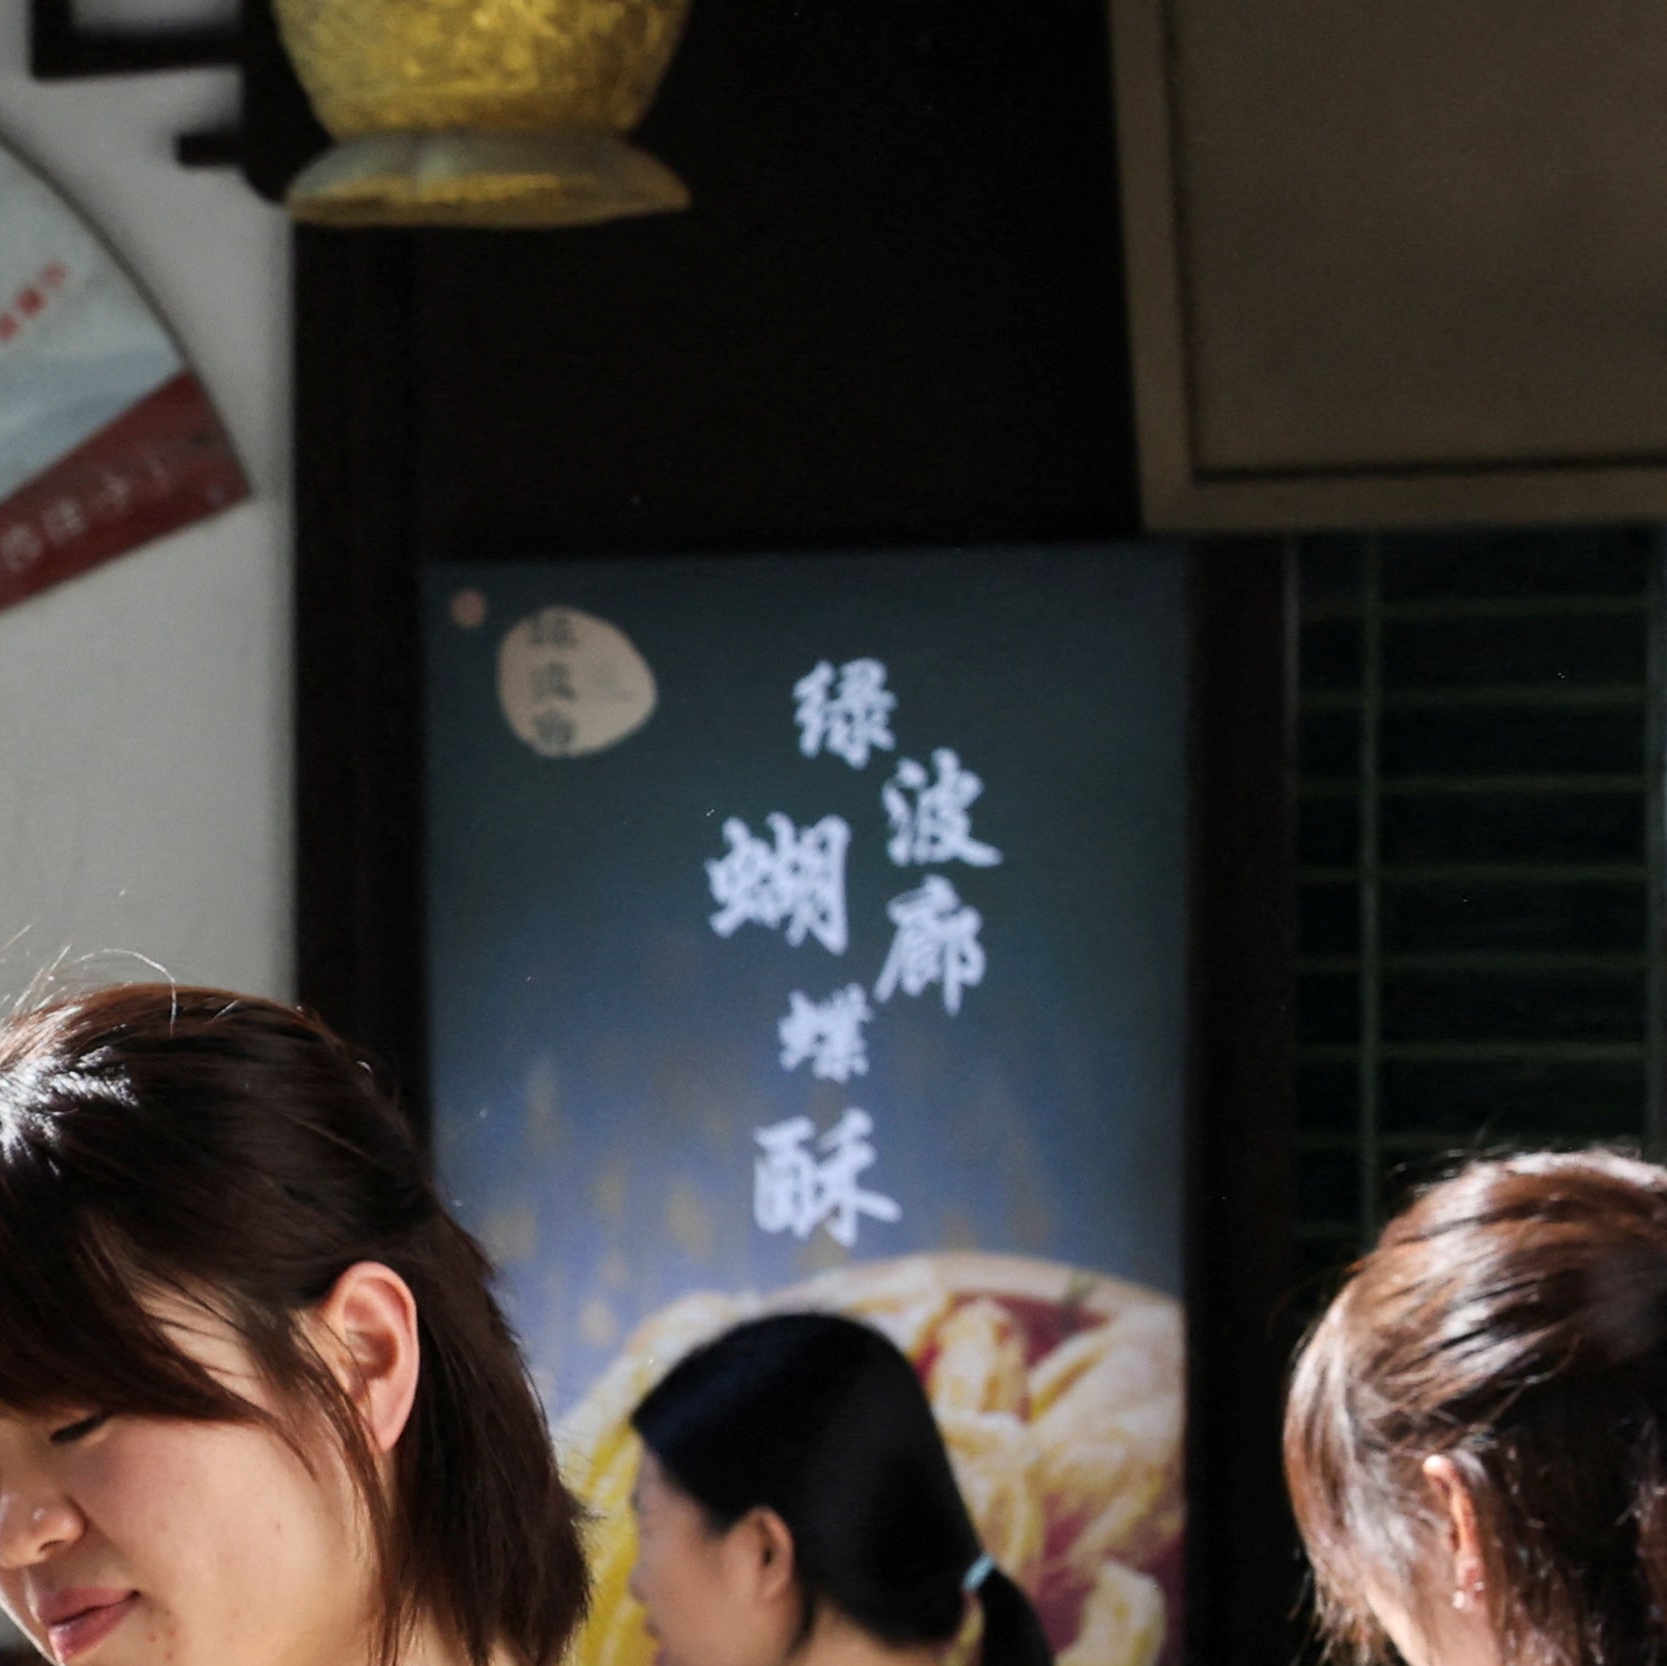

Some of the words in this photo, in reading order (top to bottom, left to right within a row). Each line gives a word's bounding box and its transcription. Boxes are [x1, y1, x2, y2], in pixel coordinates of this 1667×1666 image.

[703, 811, 903, 1247] 蝴蝶酥
[792, 656, 1003, 1016] 绿波廊
